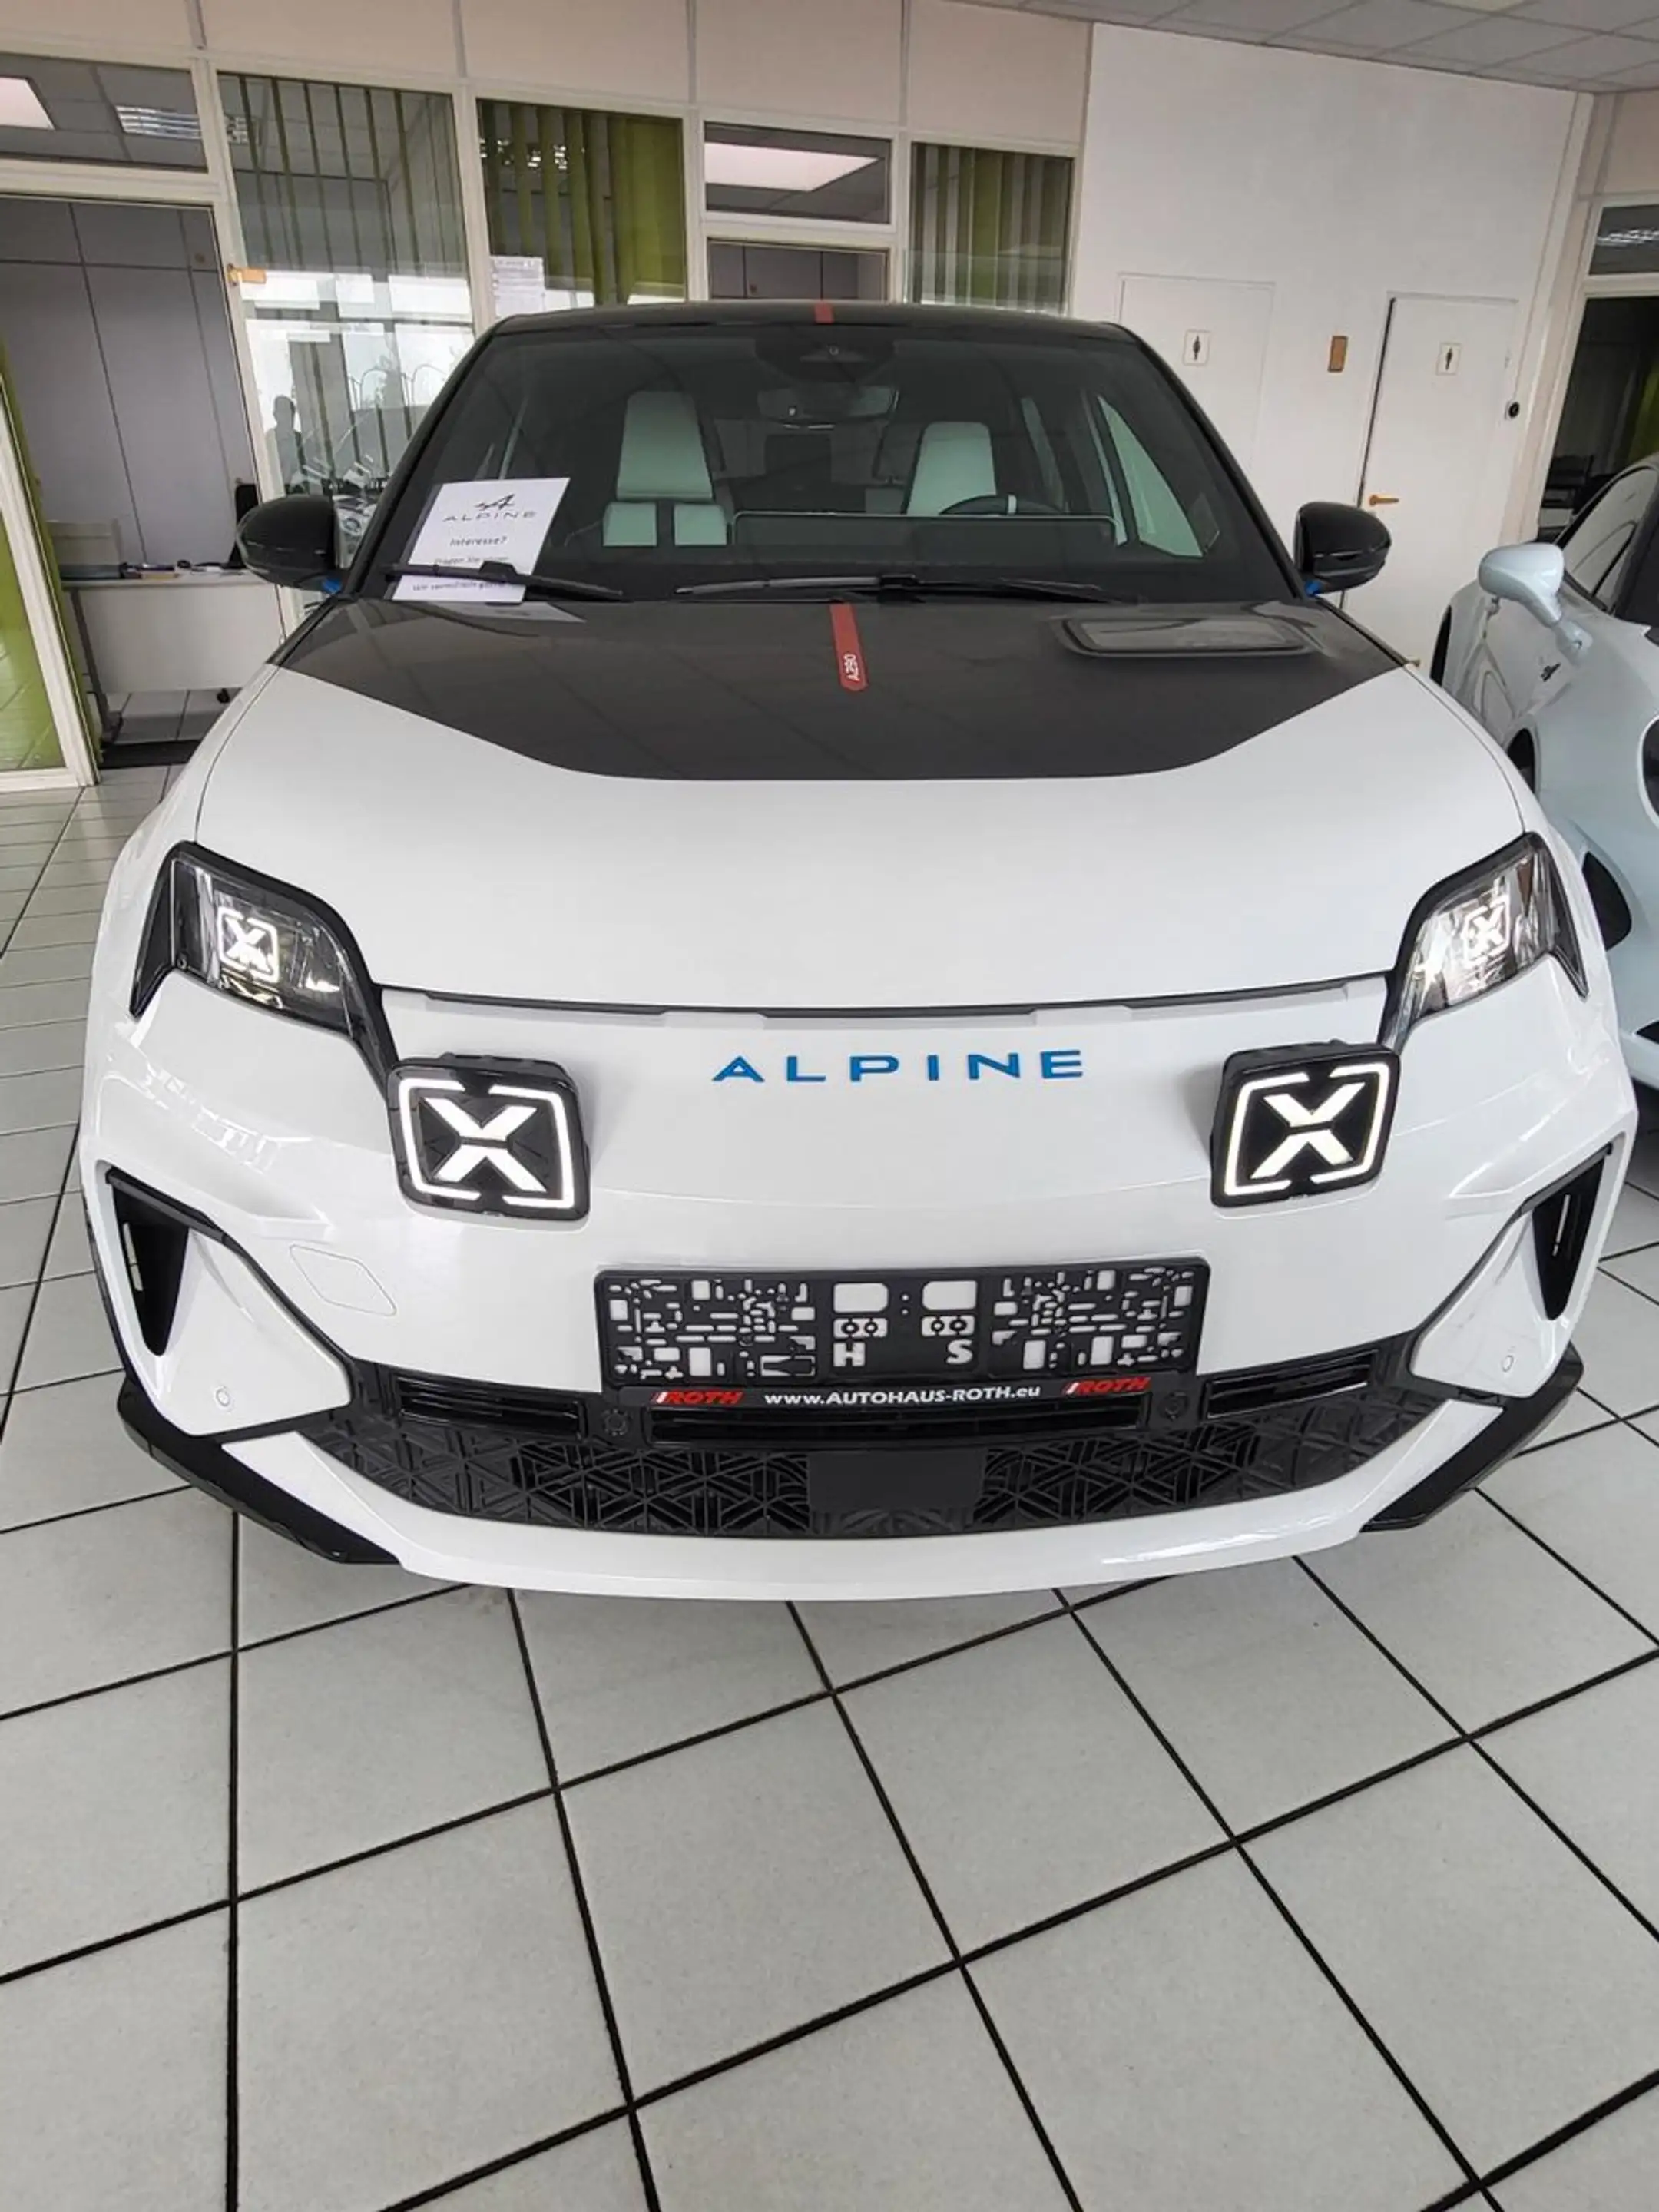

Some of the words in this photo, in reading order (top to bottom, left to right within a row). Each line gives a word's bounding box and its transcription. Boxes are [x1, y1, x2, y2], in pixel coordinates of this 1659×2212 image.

[442, 511, 536, 522] ALPINE
[712, 1049, 1084, 1082] ALPINE
[667, 1390, 743, 1405] ROTH
[764, 1386, 1041, 1405] www.AUTOHAUS-ROTH.eu
[1078, 1376, 1151, 1395] ROTH
